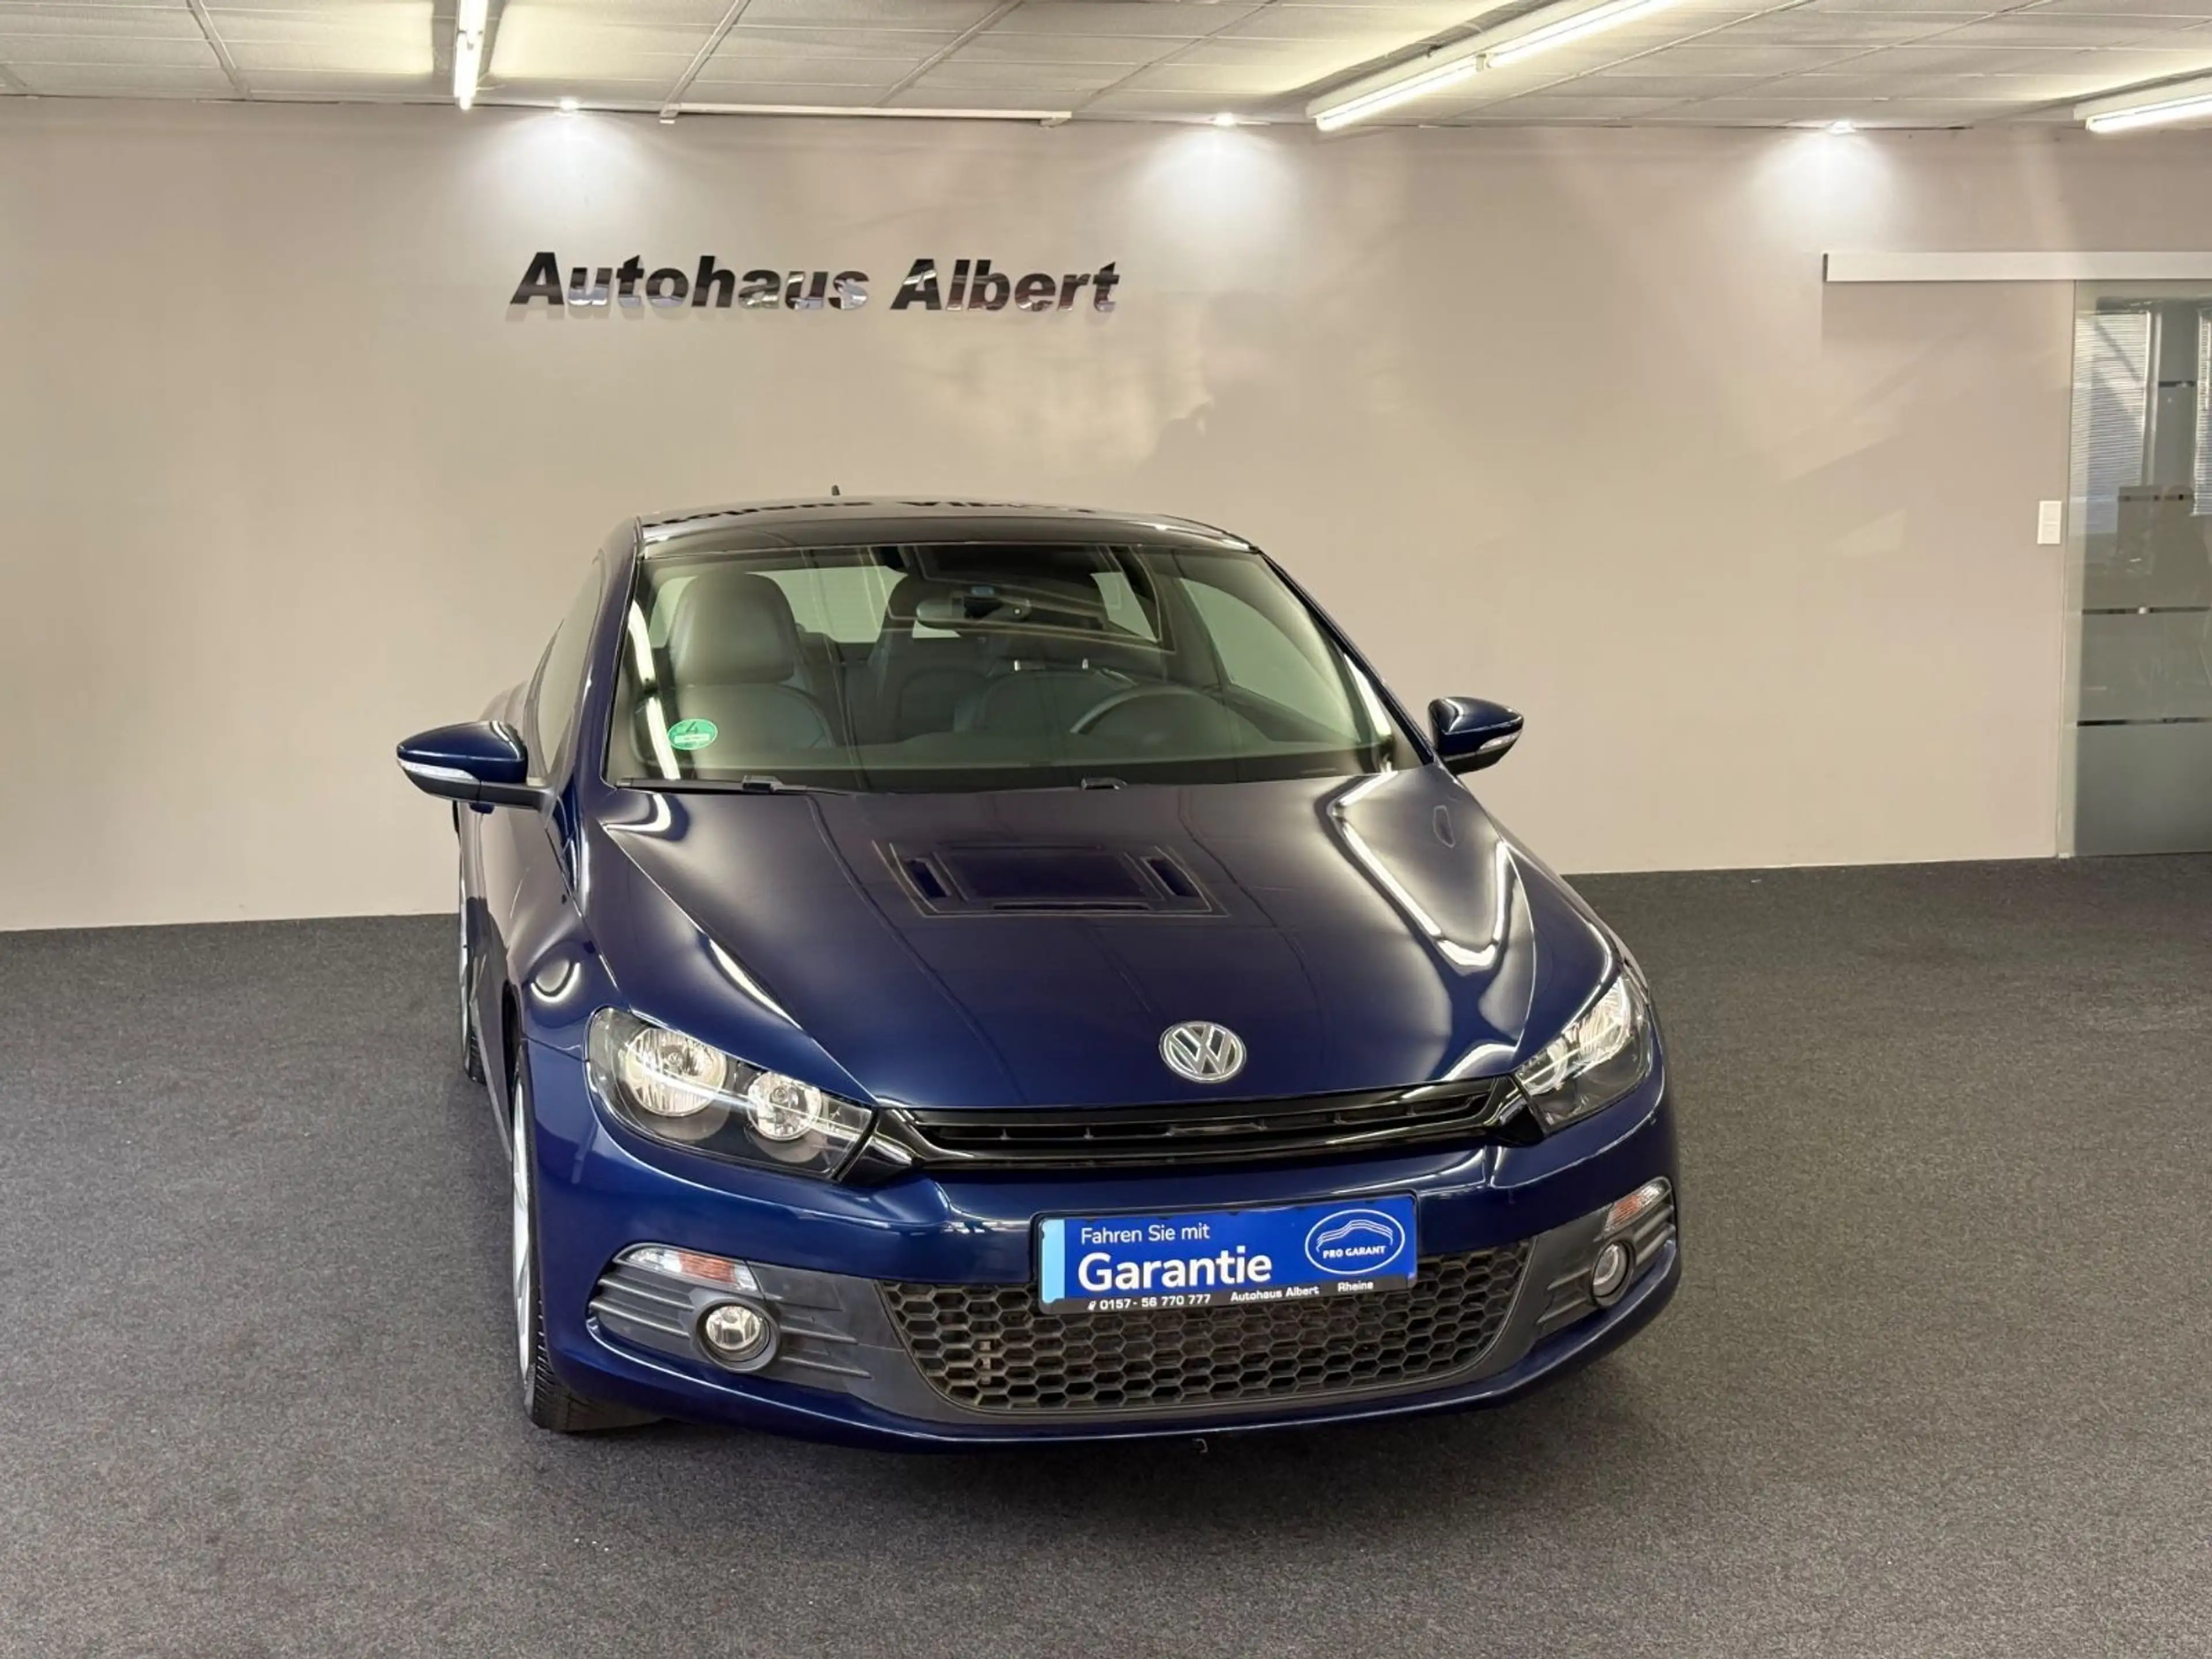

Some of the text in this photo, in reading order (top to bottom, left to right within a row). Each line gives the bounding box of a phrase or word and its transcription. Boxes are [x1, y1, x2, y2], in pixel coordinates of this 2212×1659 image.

[510, 252, 1120, 312] Autohaus Albert
[1081, 1222, 1210, 1245] Fahren Sie mit
[1323, 1245, 1387, 1259] PRO GARANT
[1078, 1246, 1271, 1291] Garantie
[1230, 1285, 1320, 1302] Autohaus Albert
[1337, 1281, 1374, 1293] Rheine
[1161, 1296, 1184, 1306] 770
[1188, 1294, 1211, 1305] 777
